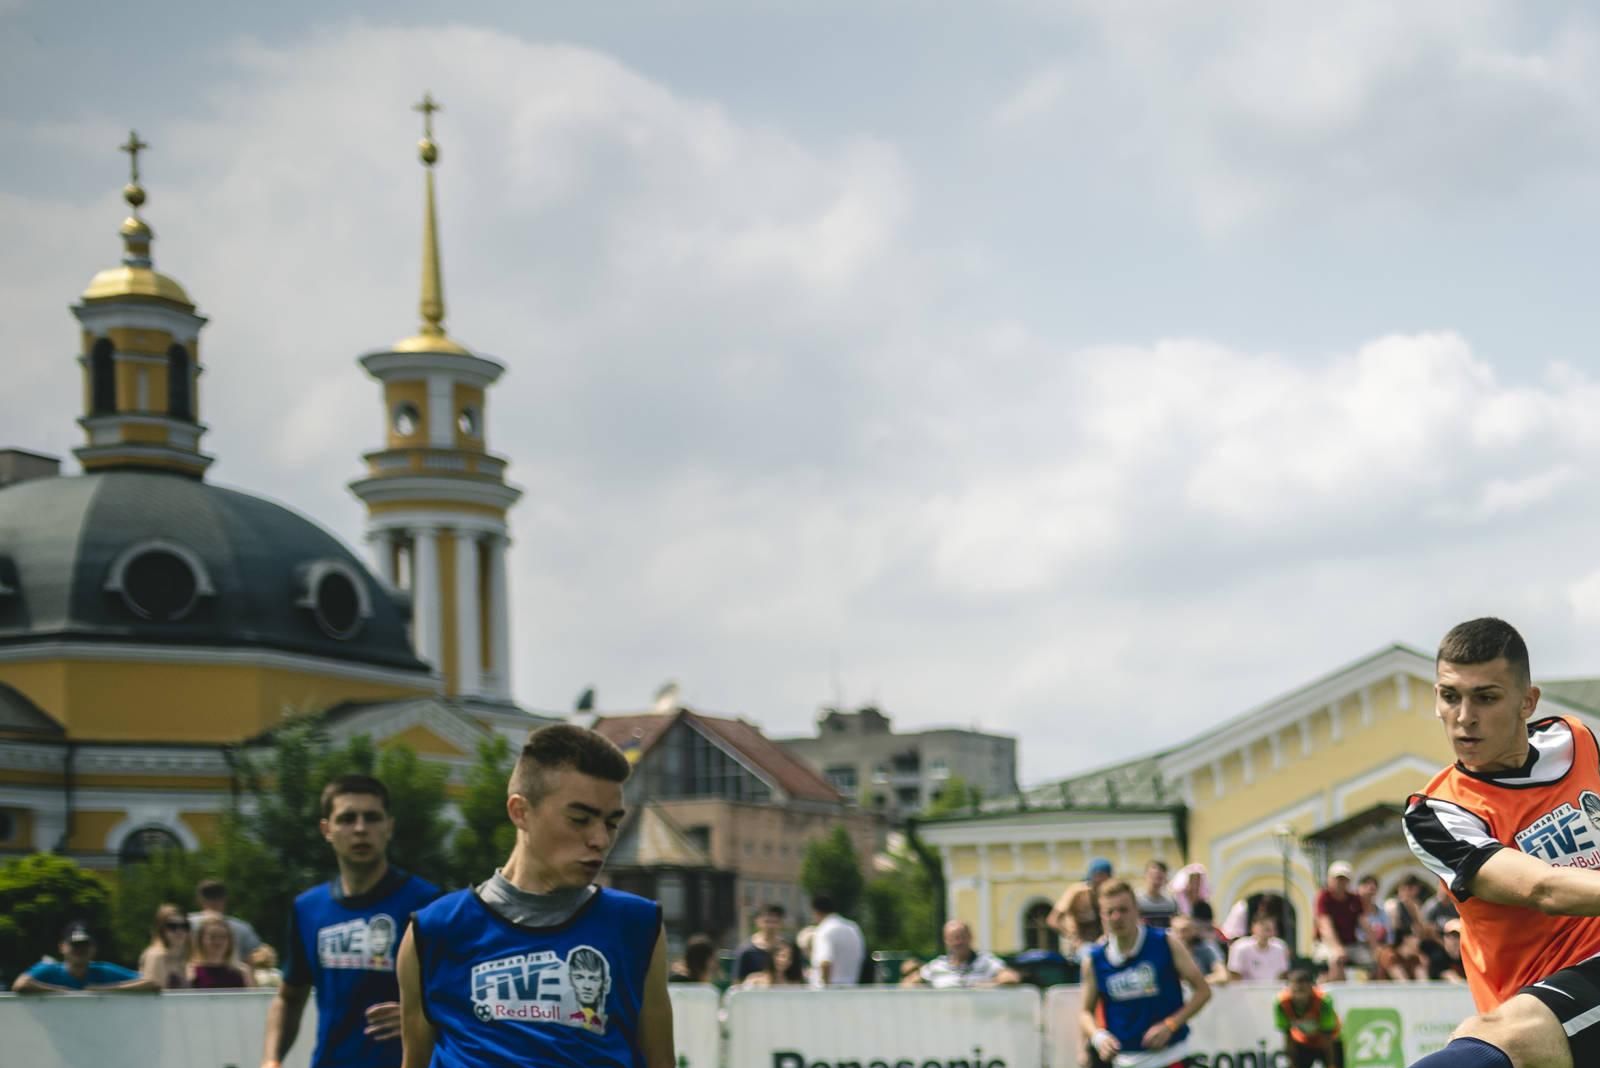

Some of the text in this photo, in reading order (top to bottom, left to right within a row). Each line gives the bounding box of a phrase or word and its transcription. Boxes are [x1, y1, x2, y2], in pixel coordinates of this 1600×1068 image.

[1516, 815, 1553, 841] NEYMAR
[1521, 811, 1596, 860] FIVE
[475, 961, 562, 1001] FIVE
[495, 1004, 561, 1020] Red Bull
